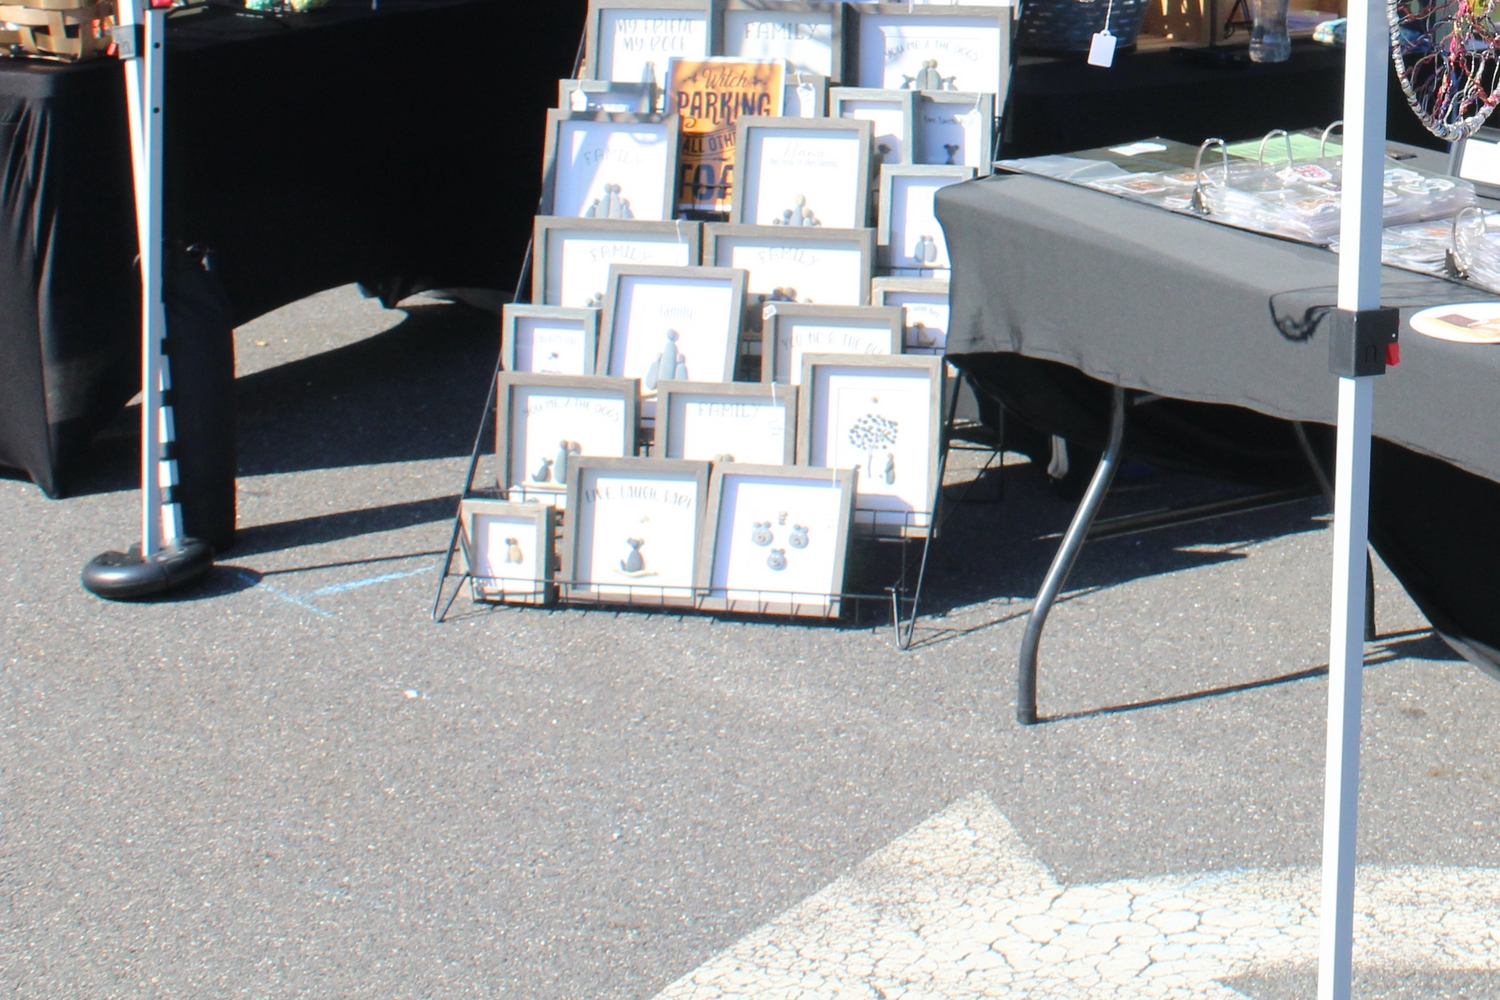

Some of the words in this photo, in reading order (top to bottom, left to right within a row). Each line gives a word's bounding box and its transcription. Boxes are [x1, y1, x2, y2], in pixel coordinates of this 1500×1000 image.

[616, 17, 637, 34] MY
[744, 22, 819, 41] FAMILY
[623, 35, 644, 51] MY
[906, 40, 920, 50] ME
[934, 39, 950, 50] THE
[954, 44, 979, 62] DOGS
[701, 65, 748, 89] Witch
[676, 90, 771, 128] PARKING
[583, 148, 643, 167] FAMILY
[590, 243, 650, 263] FAMILY
[757, 246, 820, 266] FAMILY
[808, 332, 821, 344] ME
[842, 333, 861, 349] THE
[545, 397, 559, 409] ME
[574, 398, 591, 411] THE
[594, 403, 620, 422] DOGS
[697, 401, 762, 418] FAMILY
